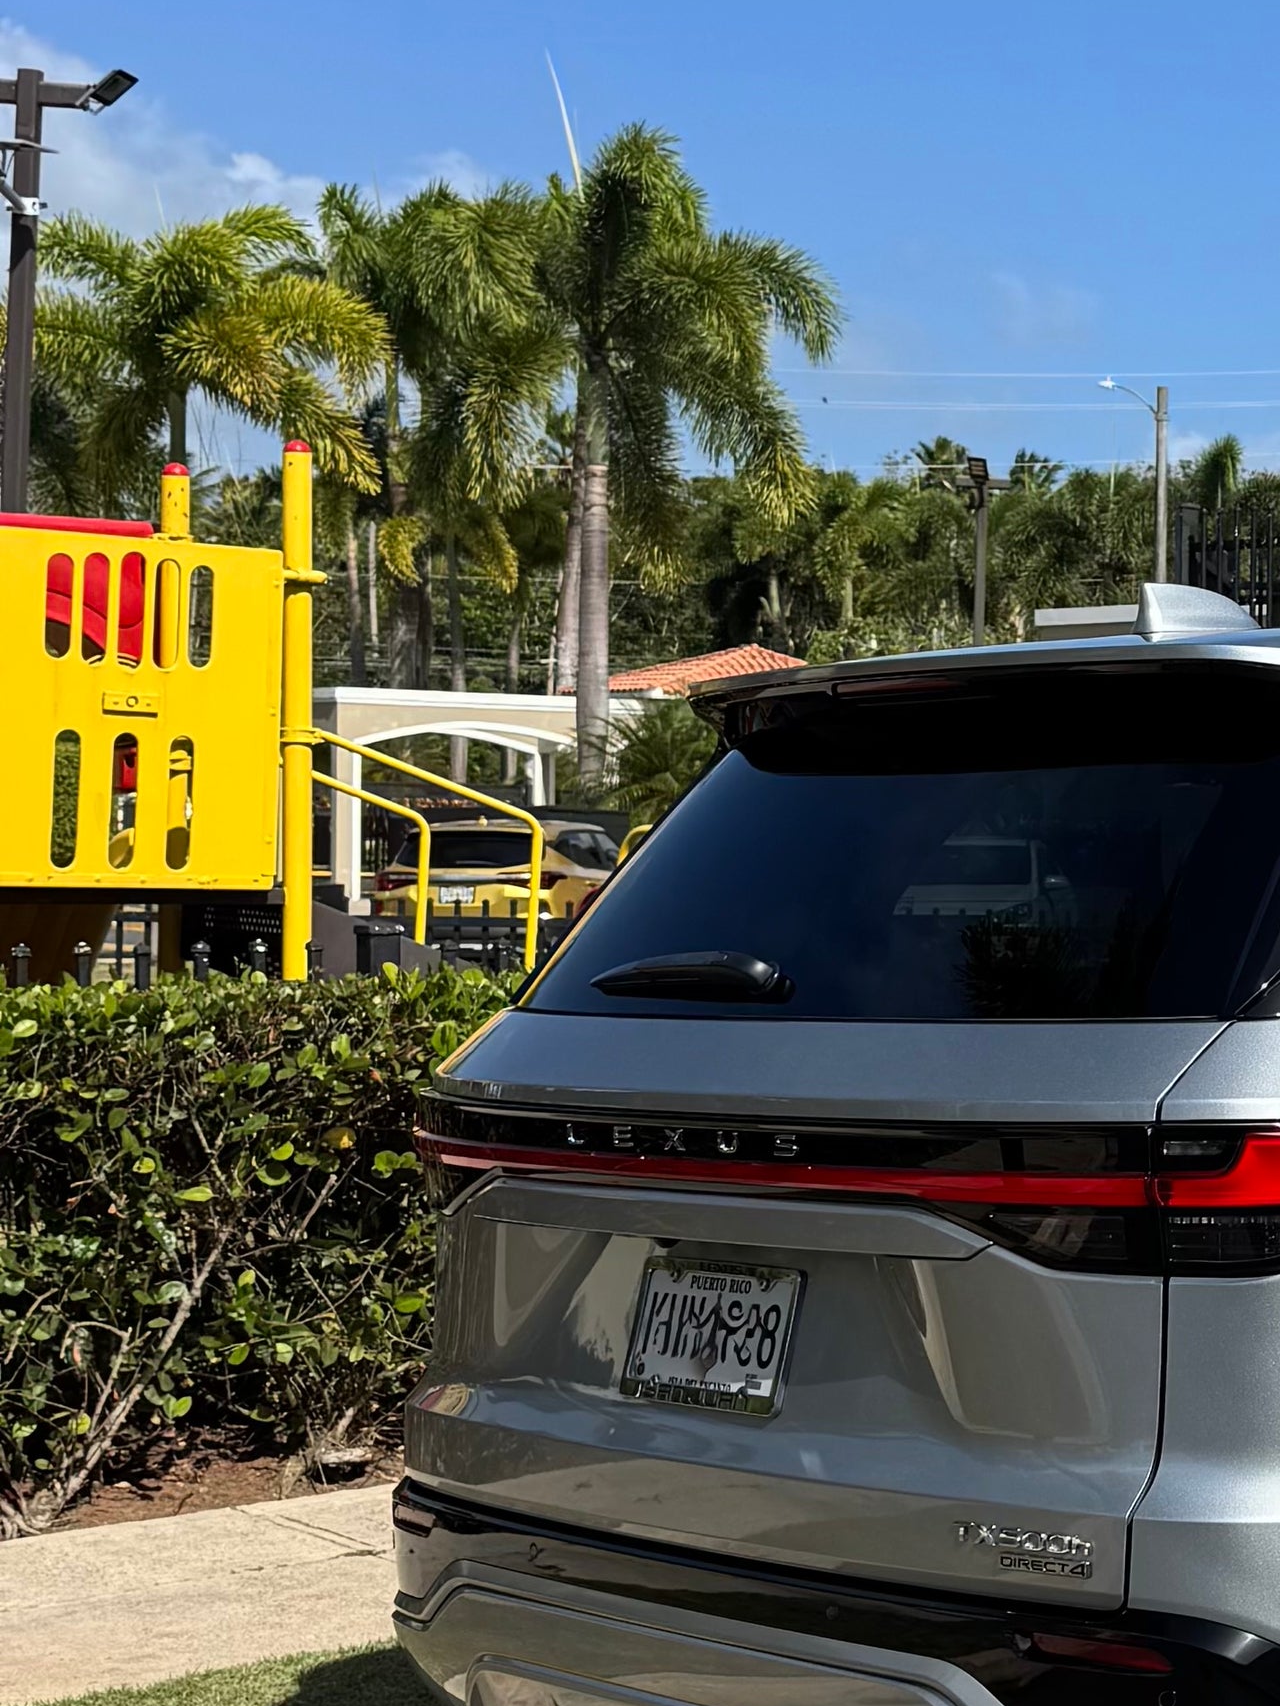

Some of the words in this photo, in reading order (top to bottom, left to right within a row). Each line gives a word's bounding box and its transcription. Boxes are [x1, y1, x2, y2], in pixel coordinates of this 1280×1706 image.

[565, 1123, 800, 1156] LEXUS
[690, 1275, 727, 1292] PUERTO
[729, 1279, 752, 1294] RICO
[1000, 1555, 1087, 1578] DIRECT4
